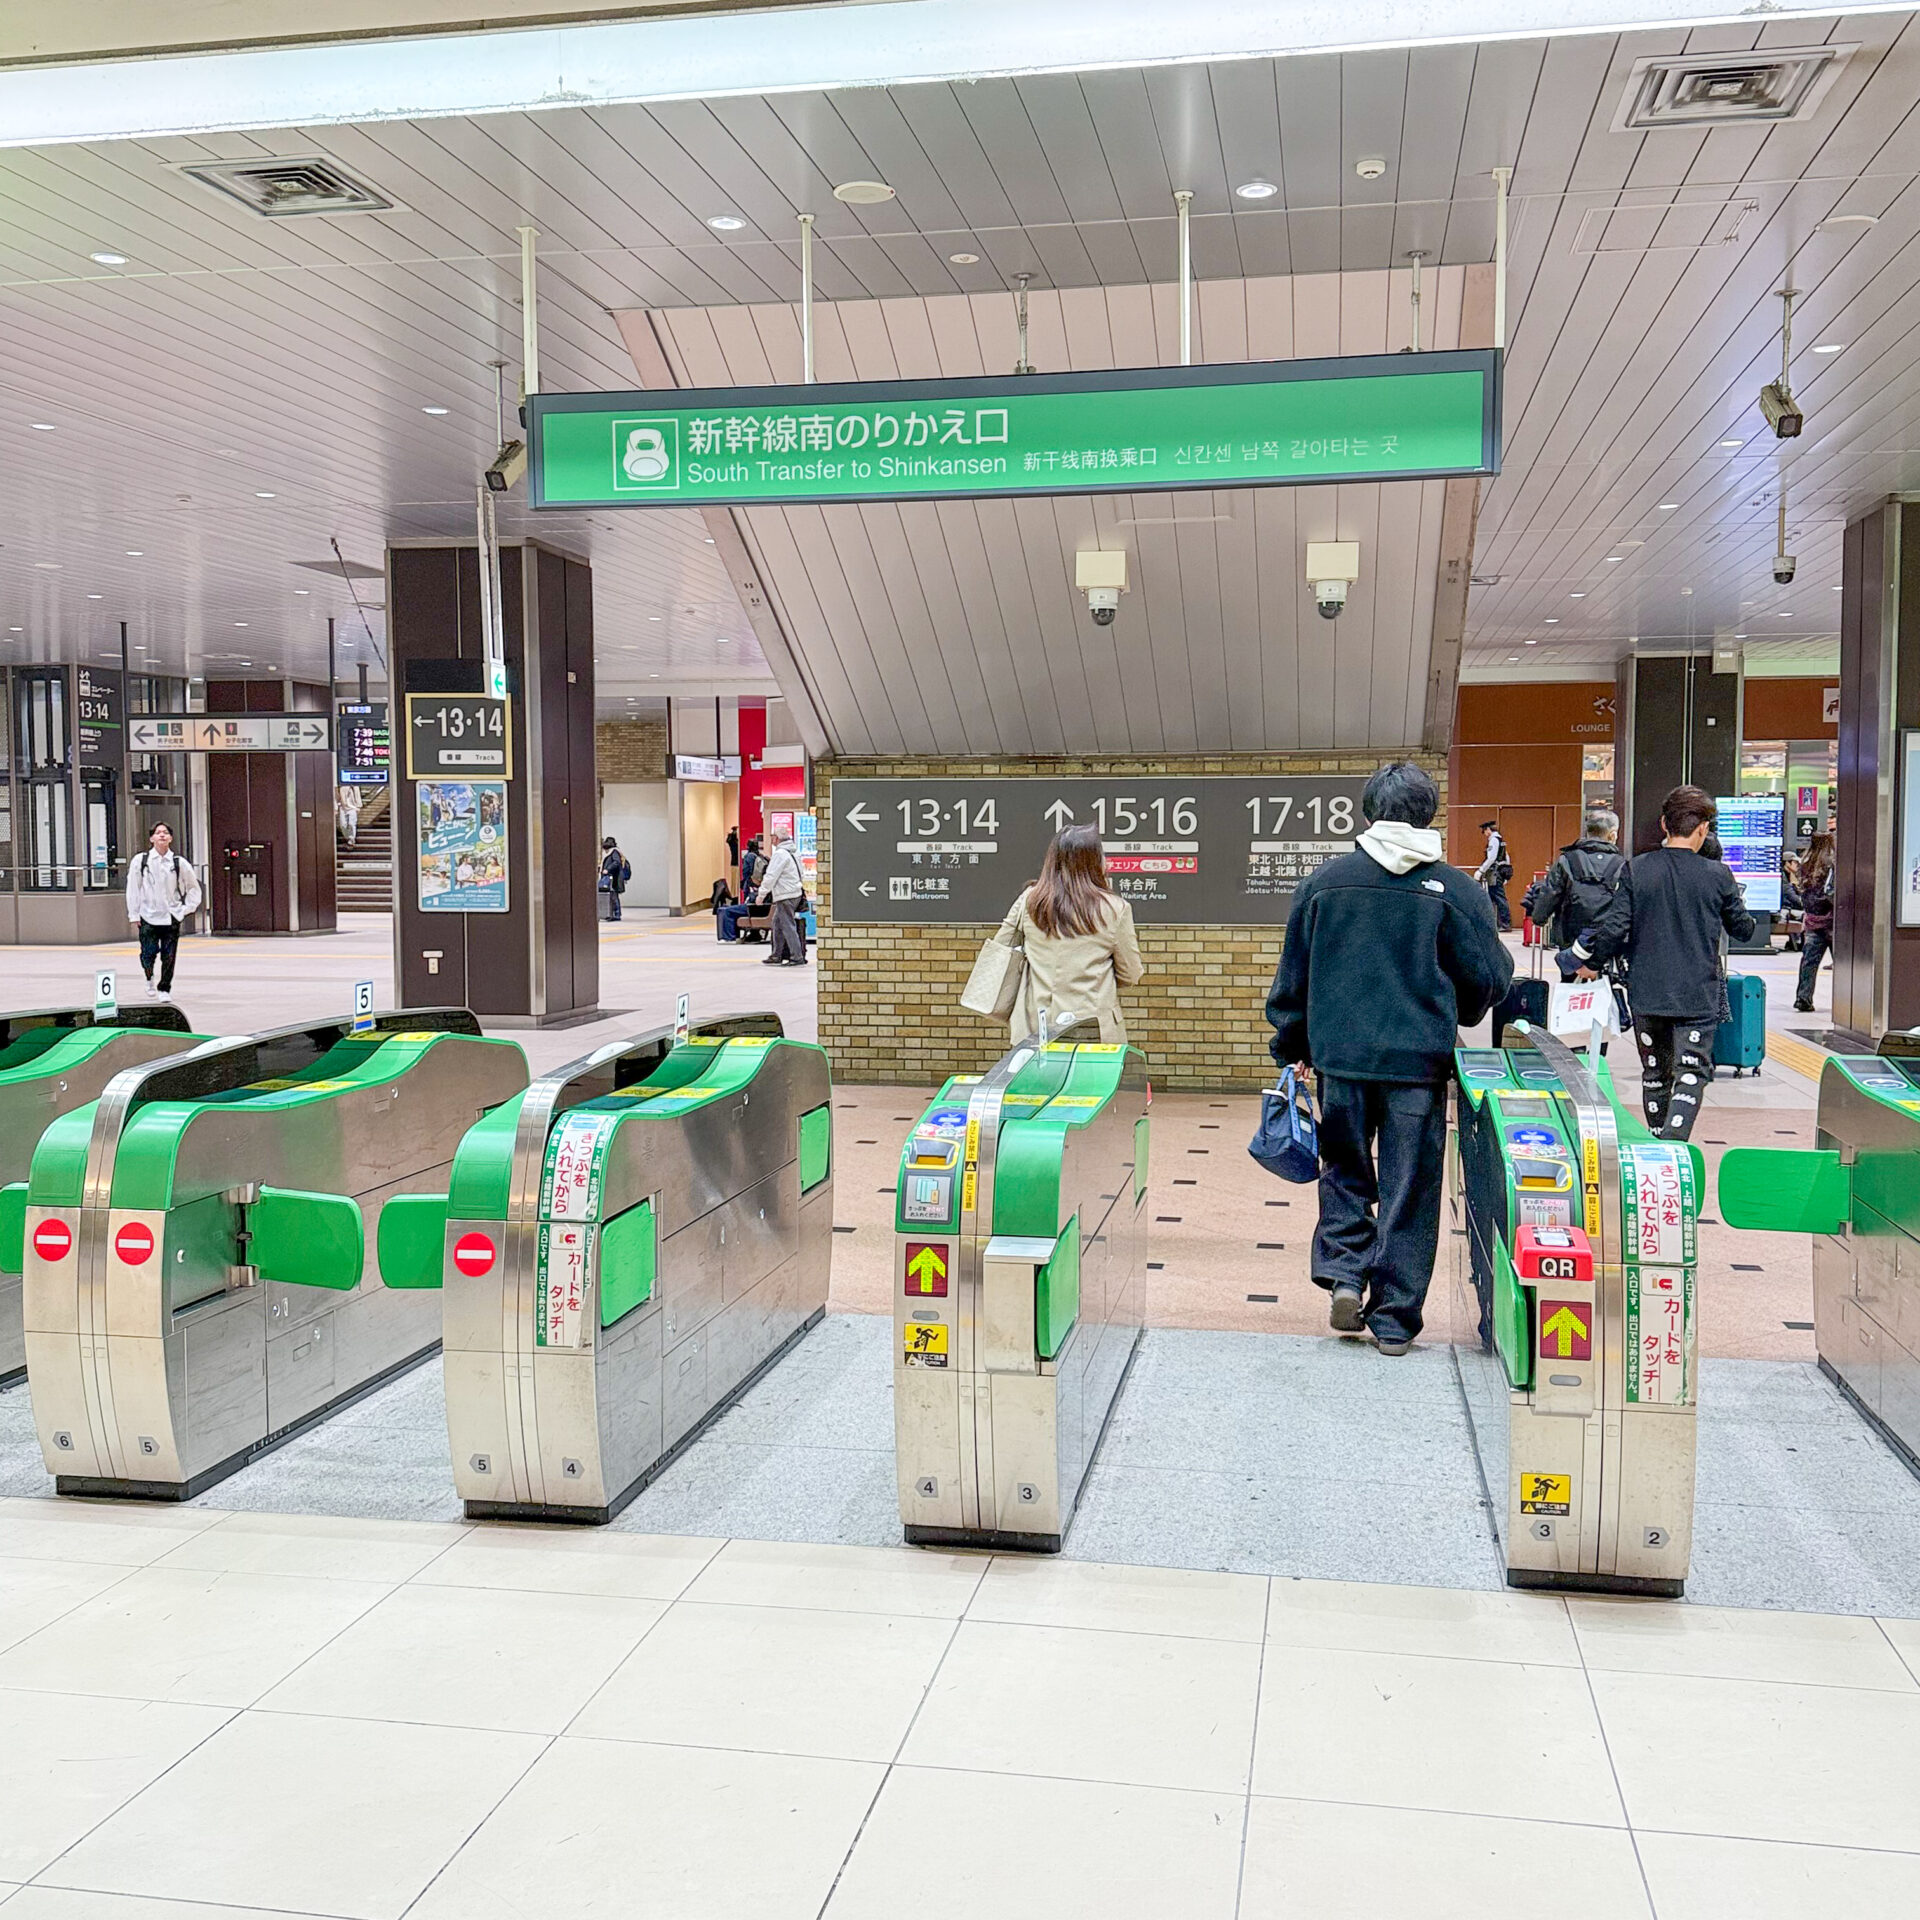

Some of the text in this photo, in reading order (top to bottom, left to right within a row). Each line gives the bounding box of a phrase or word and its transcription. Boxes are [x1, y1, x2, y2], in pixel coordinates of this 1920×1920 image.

[687, 408, 1009, 456] 新幹線南のりかえ口
[1174, 434, 1399, 465] 신칸센 남쪽 갈아타는 곳
[1023, 447, 1157, 472] 新干线南换乘口
[687, 455, 1007, 484] South Transfer to Shinkansen
[1570, 724, 1611, 733] LOUNGE
[475, 753, 496, 761] Track
[953, 843, 974, 851] Track
[1152, 843, 1173, 851] Track
[1312, 843, 1333, 851] Track
[912, 853, 979, 865] 東京方面
[1143, 861, 1169, 870] こちら
[912, 878, 950, 891] 化粧室
[1118, 878, 1158, 892] 待合所
[912, 892, 950, 900] Restrooms
[1149, 892, 1167, 900] Area
[101, 976, 111, 995] 6
[359, 987, 369, 1009] 5
[679, 999, 686, 1020] 4
[573, 1133, 595, 1187] きっぷを
[554, 1141, 574, 1213] 入れてから
[1661, 1164, 1680, 1227] きっぷを
[1640, 1173, 1660, 1255] 入れてから
[1541, 1257, 1575, 1278] QR
[566, 1251, 582, 1312] カードを
[1664, 1298, 1681, 1366] カードを
[1642, 1335, 1660, 1401] タッチ!
[59, 1434, 70, 1447] 6
[144, 1441, 153, 1453] 5
[477, 1459, 487, 1472] 5
[566, 1462, 576, 1475] 4
[923, 1482, 934, 1493] 4
[1022, 1488, 1032, 1499] 3
[1539, 1524, 1551, 1537] 3
[1648, 1532, 1660, 1545] 2
